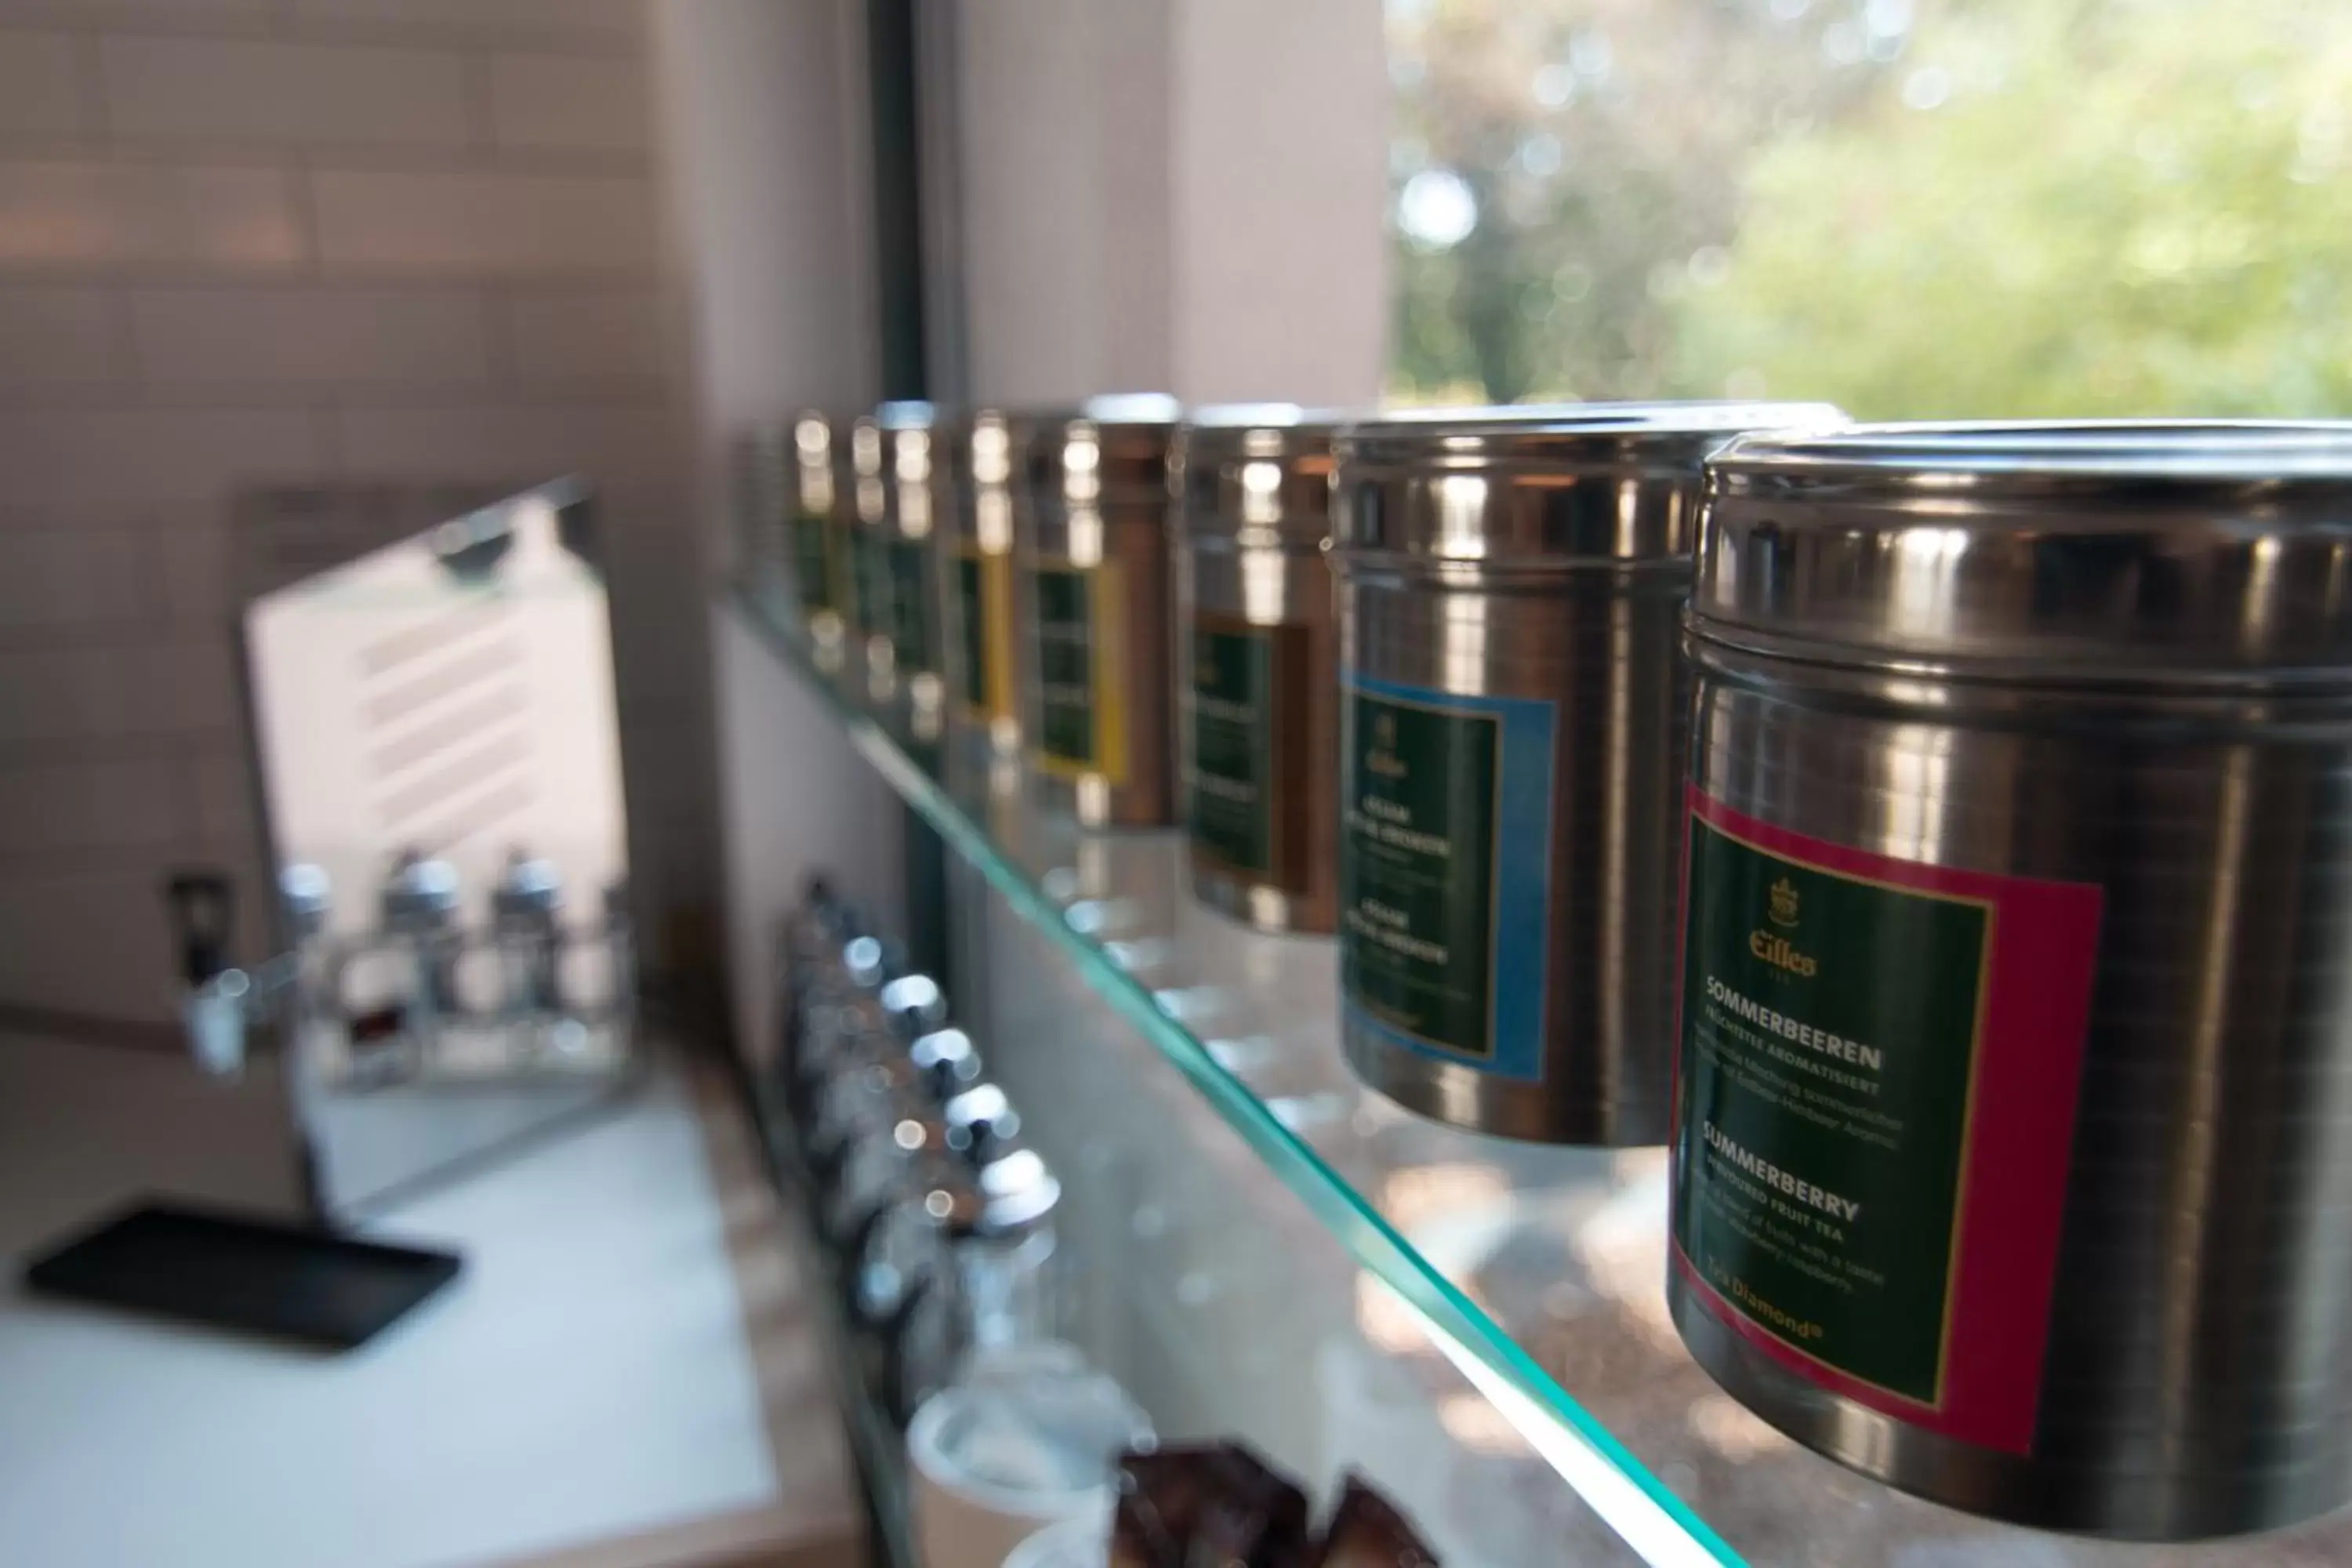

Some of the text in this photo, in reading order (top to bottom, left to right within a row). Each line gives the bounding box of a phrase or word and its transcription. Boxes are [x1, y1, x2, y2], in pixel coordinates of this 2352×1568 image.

[1749, 927, 1818, 978] Eilles
[1706, 975, 1882, 1071] SOMMERBEEREN
[1766, 1043, 1881, 1096] AROMATISIERT
[1702, 1120, 1860, 1223] SUMMERBERRY
[1770, 1200, 1813, 1229] FRUIT
[1814, 1219, 1844, 1243] TEA
